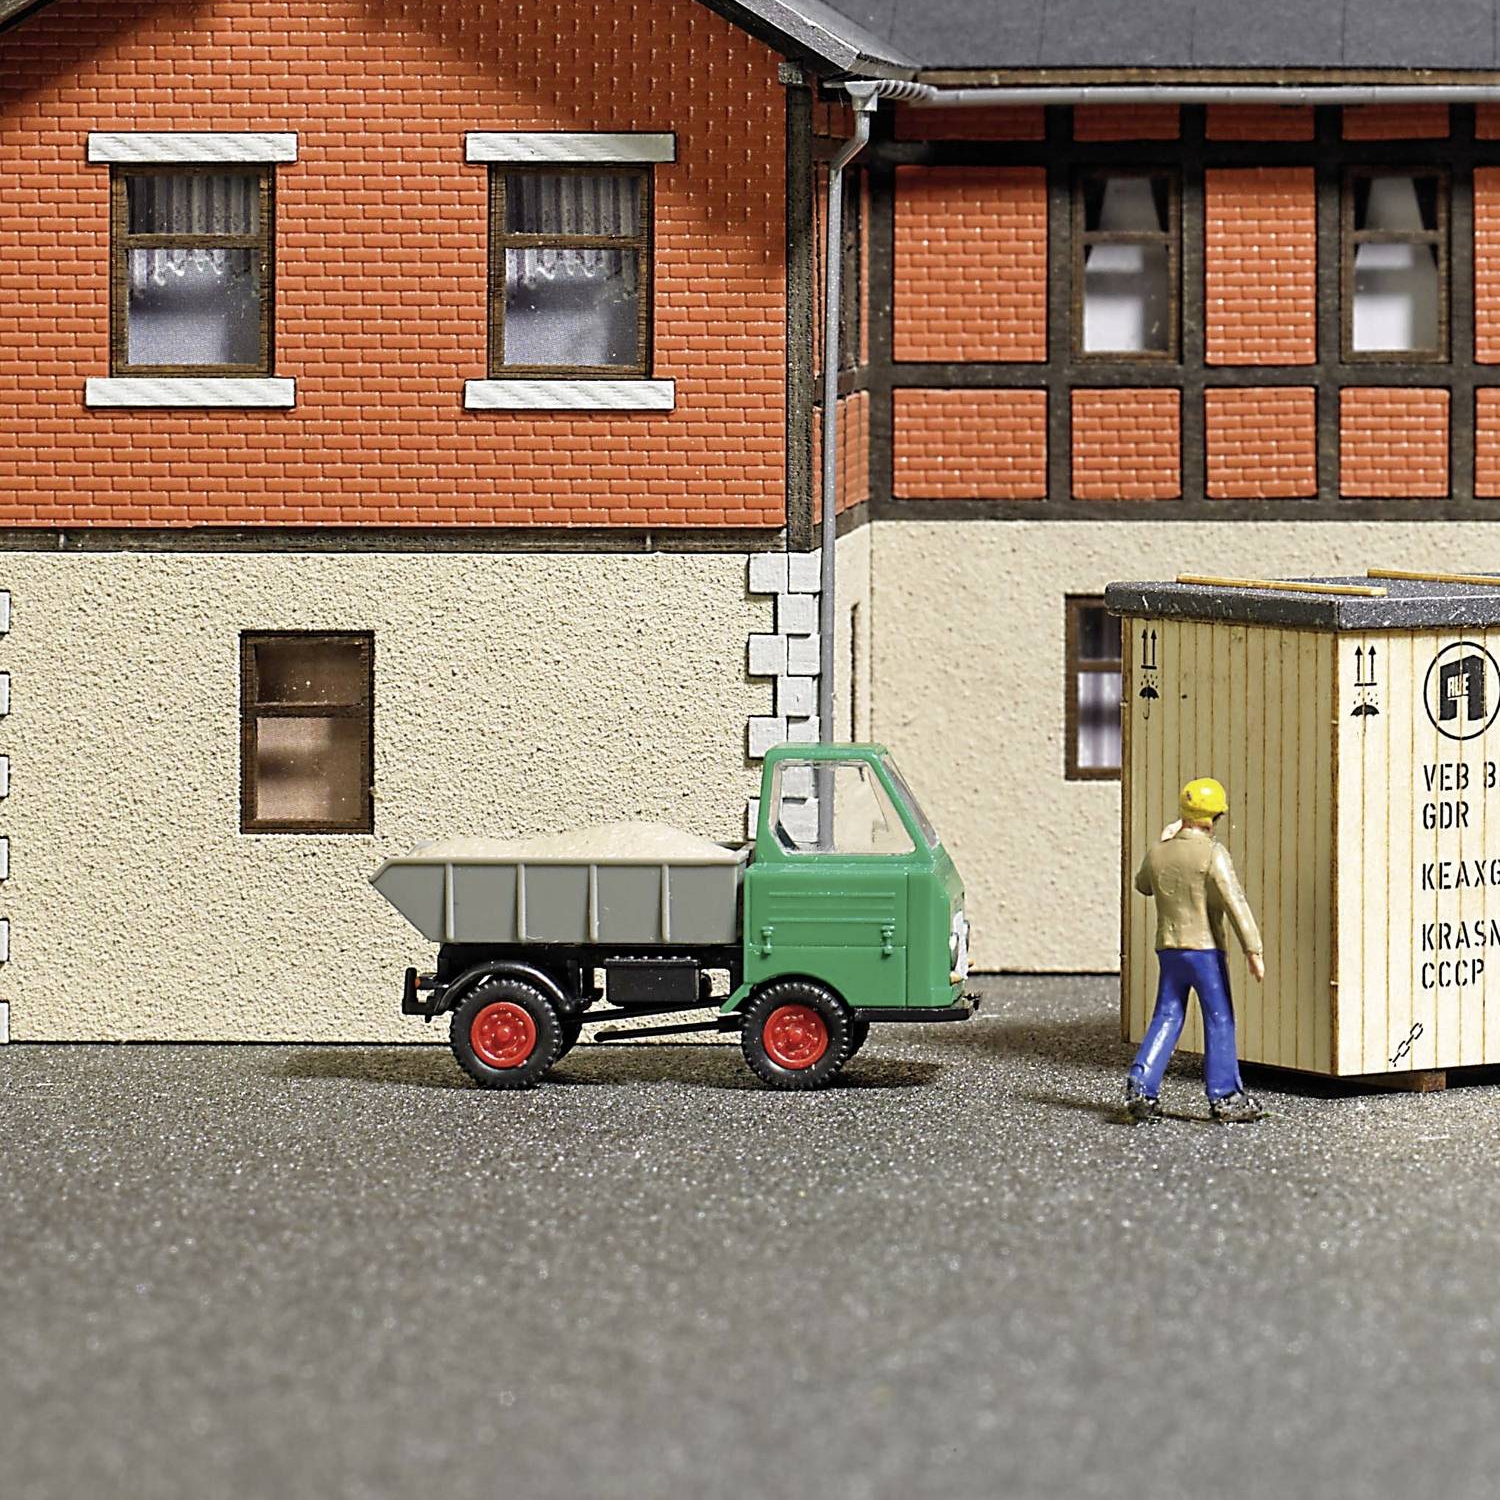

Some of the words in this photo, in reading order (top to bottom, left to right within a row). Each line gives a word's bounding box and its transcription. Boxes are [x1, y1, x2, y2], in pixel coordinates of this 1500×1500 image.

[1447, 673, 1470, 698] AUE
[1424, 763, 1468, 791] VEB
[1423, 802, 1468, 829] GDR
